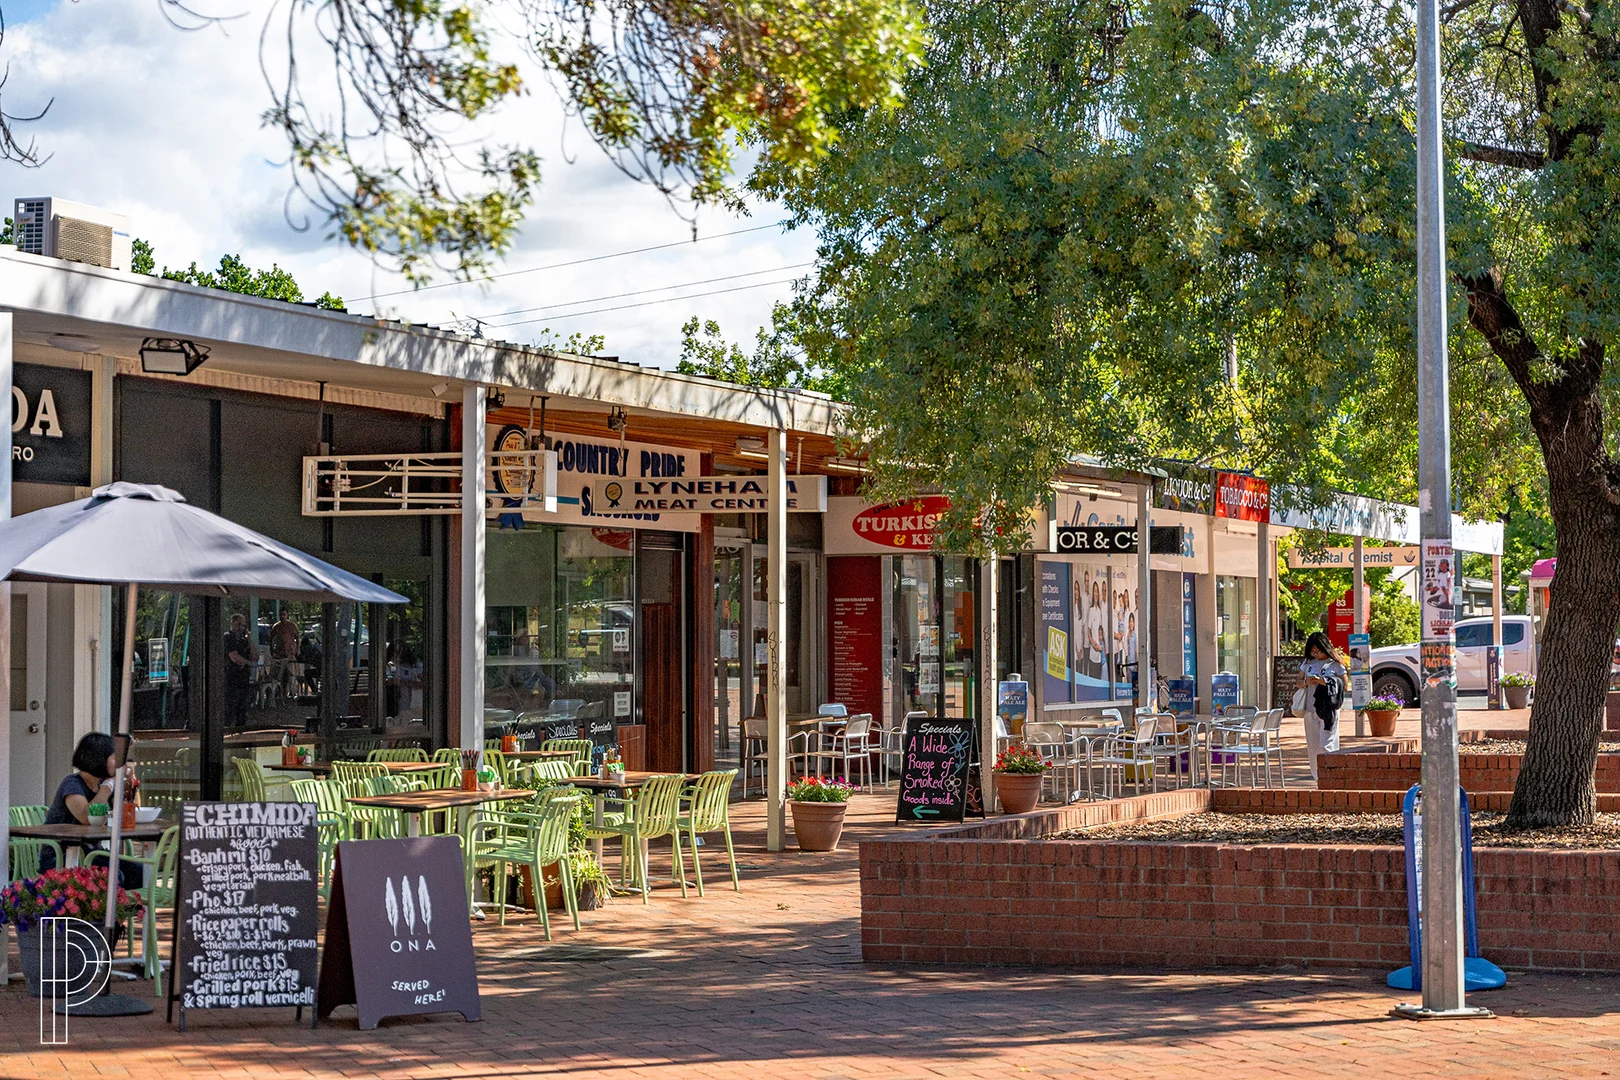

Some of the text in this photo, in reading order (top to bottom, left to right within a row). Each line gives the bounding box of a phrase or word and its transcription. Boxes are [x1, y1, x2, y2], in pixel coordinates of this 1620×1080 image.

[554, 440, 629, 477] COUNTRY
[641, 450, 685, 478] PRIDE
[1164, 477, 1194, 499] LIQUOR
[1194, 481, 1201, 500] &
[634, 498, 798, 510] MEAT CENTE
[1220, 486, 1253, 507] TOBACCO
[1253, 491, 1259, 509] &
[893, 534, 907, 546] &
[1057, 531, 1090, 549] OR
[1093, 531, 1110, 549] &
[1348, 551, 1393, 564] Cemist
[1425, 568, 1436, 579] 22
[1050, 631, 1066, 659] ASK
[548, 722, 578, 739] Specials
[590, 721, 612, 735] Specials
[918, 723, 962, 735] Specials
[908, 735, 948, 754] A Wide
[908, 753, 955, 778] Range of
[904, 773, 944, 790] Smoked
[903, 790, 930, 805] Goods
[931, 792, 954, 805] inside
[195, 802, 318, 827] CHIMIDA
[185, 825, 305, 840] AUTHENTIC VIETNAMESE
[228, 849, 246, 863] mi
[248, 848, 272, 863] $10
[203, 880, 255, 892] vegetarian
[223, 889, 246, 906] $17
[220, 917, 257, 934] paper
[259, 915, 290, 933] rolls
[288, 938, 317, 951] prawn
[205, 950, 224, 959] veg
[232, 955, 261, 970] rice
[262, 952, 288, 971] $15
[243, 978, 277, 993] pork
[278, 978, 300, 992] $15
[391, 979, 430, 992] SERVED
[184, 986, 315, 1008] & spring roll vermicelli
